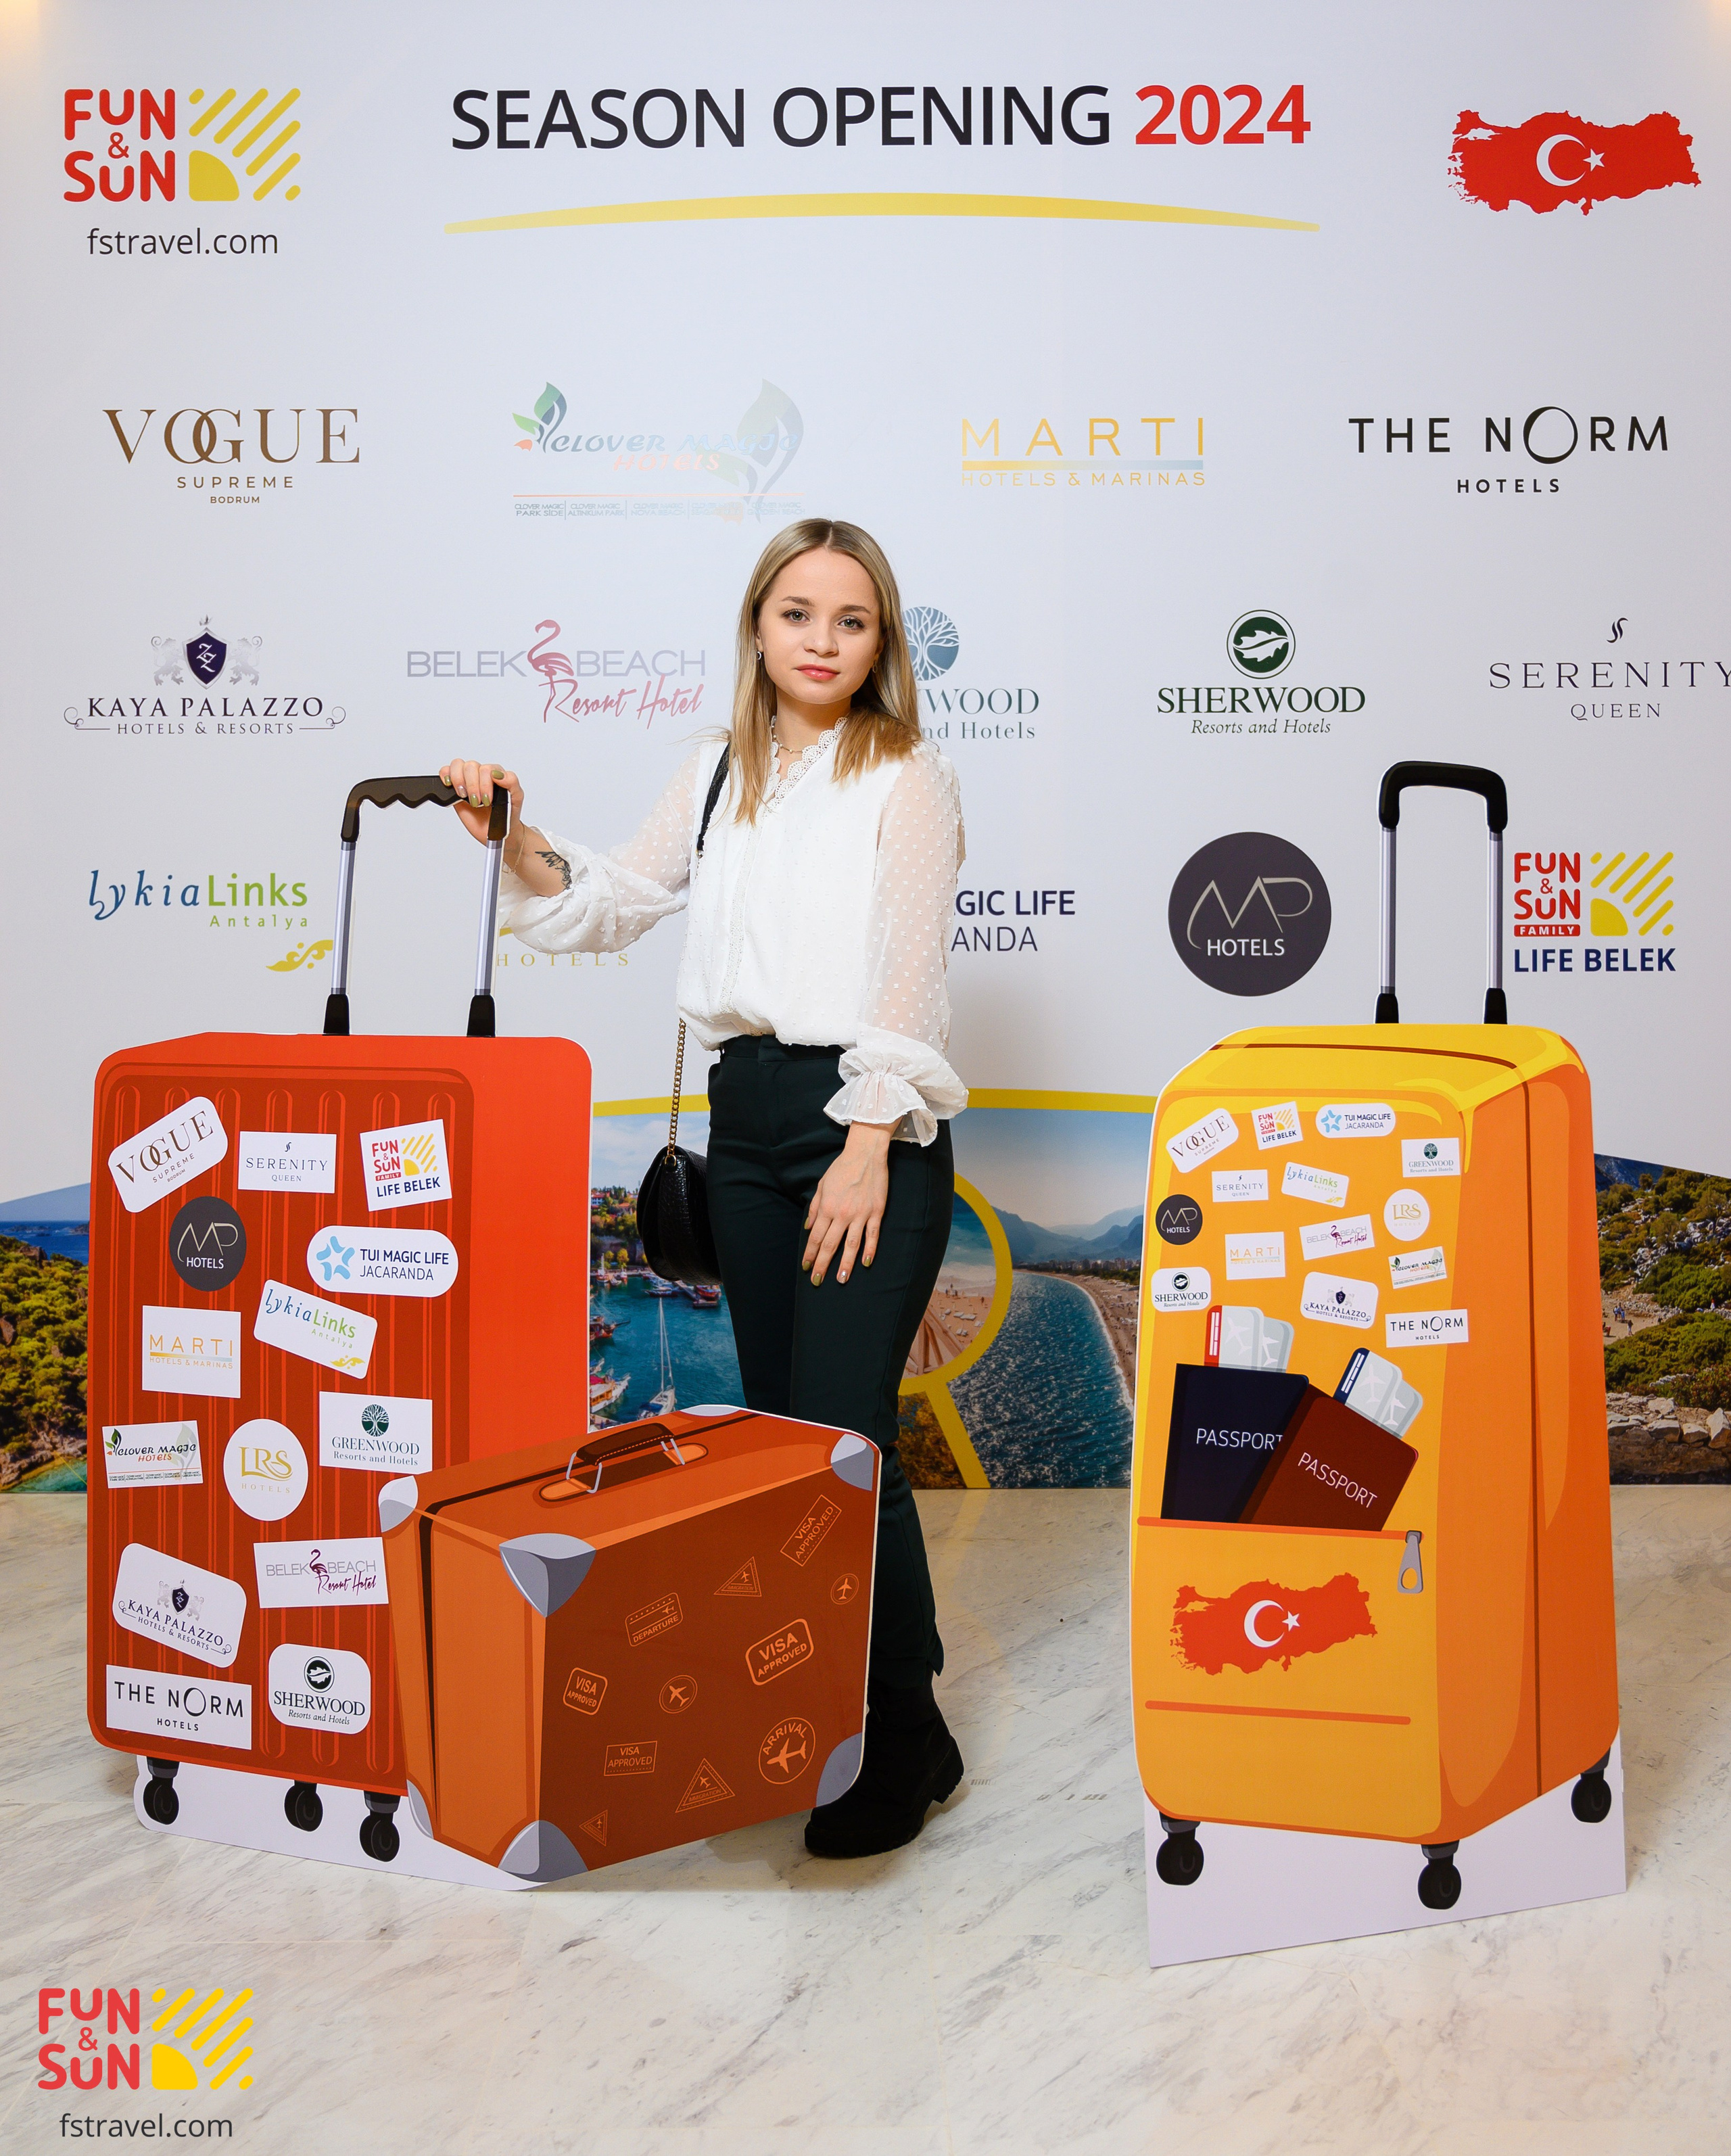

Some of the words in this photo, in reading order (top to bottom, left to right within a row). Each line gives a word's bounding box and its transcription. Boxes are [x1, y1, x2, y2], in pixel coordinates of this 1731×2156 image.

[64, 89, 175, 141] FUN
[452, 88, 744, 150] SEASON
[773, 85, 1110, 148] OPENING
[1135, 84, 1311, 145] 2024
[108, 132, 129, 159] &
[64, 150, 175, 202] SUN
[87, 227, 278, 255] fstravel.com
[102, 408, 359, 464] VOGUE
[550, 434, 665, 452] CLOVER
[678, 433, 799, 455] MAGIC
[962, 418, 1204, 456] MARTI
[1348, 417, 1450, 453] THE
[1486, 406, 1668, 464] NORM
[613, 453, 720, 471] HOTELS
[177, 476, 293, 488] SUPREME
[962, 473, 1056, 486] HOTELS
[1068, 473, 1080, 486] &
[1092, 473, 1205, 486] MARINAS
[1458, 479, 1559, 493] HOTELS
[407, 651, 527, 677] BELEK
[577, 650, 705, 676] BEACH
[1490, 661, 1731, 688] SERENITY
[87, 698, 168, 718] KAYA
[181, 697, 323, 717] PALAZZO
[539, 678, 636, 724] Resort
[637, 674, 704, 730] Hotel
[1157, 686, 1365, 713] SHERWOOD
[1571, 703, 1660, 721] QUEEN
[118, 724, 185, 734] HOTELS
[195, 722, 208, 734] &
[217, 724, 293, 734] RESORTS
[922, 722, 948, 739] nd
[961, 722, 1035, 739] Hotels
[1191, 720, 1242, 734] Resorts
[1249, 720, 1277, 733] and
[1283, 718, 1331, 733] Hotels
[1514, 852, 1580, 883] FUN
[1540, 878, 1552, 894] &
[1016, 891, 1075, 915] LIFE
[1514, 889, 1580, 920] SUN
[210, 915, 307, 930] Antalya
[1520, 926, 1575, 935] FAMILY
[1208, 939, 1284, 956] HOTELS
[497, 954, 628, 966] HOTELS
[1515, 949, 1573, 972] LIFE
[1585, 948, 1676, 972] BELEK
[1258, 1112, 1273, 1122] FUN
[1260, 1121, 1275, 1130] SUN
[1172, 1115, 1229, 1157] VOGUE
[1277, 1130, 1296, 1139] BELEK
[116, 1110, 214, 1183] VOGUE
[372, 1140, 398, 1157] FUN
[153, 1153, 195, 1183] SUPREME
[246, 1158, 328, 1171] SERENITY
[374, 1156, 400, 1173] SUN
[377, 1184, 400, 1197] LIFE
[404, 1177, 440, 1193] BELEK
[1216, 1183, 1264, 1191] SERENITY
[1307, 1232, 1331, 1244] BELEK
[1340, 1226, 1367, 1236] BEACH
[360, 1249, 379, 1261] TUI
[383, 1250, 421, 1263] MAGIC
[425, 1252, 449, 1265] LIFE
[1230, 1247, 1280, 1258] MARTI
[187, 1257, 224, 1269] HOTELS
[360, 1265, 434, 1280] JACARANDA
[1155, 1292, 1208, 1303] SHERWOOD
[1310, 1303, 1329, 1311] KAYA
[1332, 1307, 1367, 1318] PALAZZO
[1390, 1321, 1415, 1331] THE
[1421, 1316, 1463, 1332] NORM
[150, 1334, 233, 1356] MARTI
[312, 1329, 353, 1349] Antalya
[193, 1360, 233, 1369] MARINAS
[118, 1447, 153, 1455] CLOVER
[158, 1444, 196, 1453] MAGIC
[332, 1436, 419, 1455] GREENWOOD
[138, 1453, 172, 1461] HOTELS
[239, 1447, 293, 1482] LRS
[333, 1451, 366, 1461] Resorts
[369, 1455, 385, 1463] and
[389, 1455, 418, 1466] Hotels
[241, 1483, 290, 1493] HOTELS
[1298, 1452, 1377, 1508] PASSPORT
[795, 1518, 815, 1539] VISA
[796, 1507, 833, 1559] APPROVED
[266, 1563, 310, 1576] BELEK
[327, 1560, 376, 1573] BEACH
[315, 1575, 352, 1594] Resort
[352, 1572, 376, 1595] Hotel
[128, 1599, 160, 1621] KAYA
[165, 1614, 222, 1645] PALAZZO
[634, 1614, 679, 1642] DEPARTURE
[138, 1617, 166, 1632] HOTELS
[178, 1633, 209, 1650] RESORTS
[759, 1633, 798, 1660] VISA
[758, 1643, 807, 1677] APPROVED
[576, 1677, 596, 1695] VISA
[114, 1681, 155, 1704] THE
[168, 1687, 243, 1717] NORM
[274, 1691, 365, 1716] SHERWOOD
[567, 1690, 597, 1707] APPROVED
[157, 1718, 199, 1731] HOTELS
[289, 1709, 311, 1720] Resorts
[313, 1714, 327, 1722] and
[329, 1714, 350, 1725] Hotels
[763, 1723, 807, 1755] ARRIVAL
[620, 1747, 639, 1756] VISA
[608, 1756, 653, 1767] APPROVED
